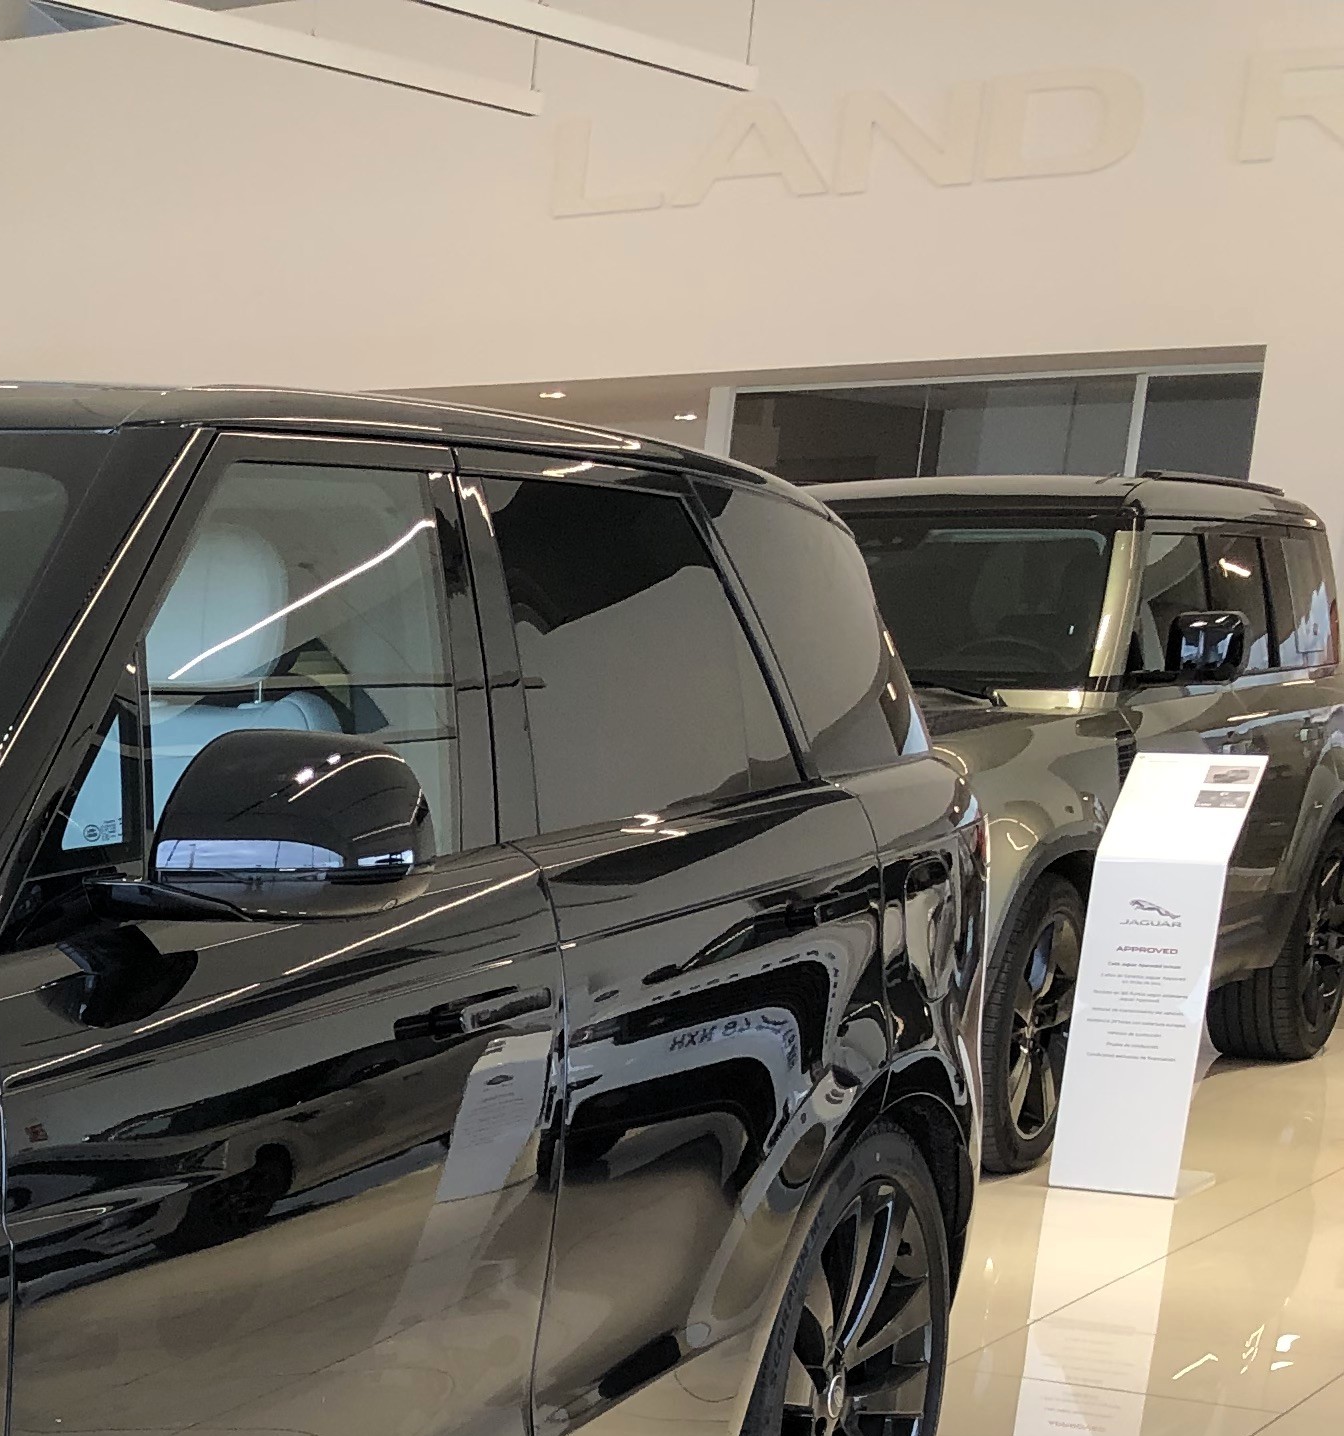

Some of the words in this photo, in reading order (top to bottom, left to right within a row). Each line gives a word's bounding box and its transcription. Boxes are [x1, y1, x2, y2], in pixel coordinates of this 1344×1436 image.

[551, 67, 1144, 219] LAND
[1119, 919, 1182, 928] JAGUAR
[1116, 945, 1179, 955] APPROVED
